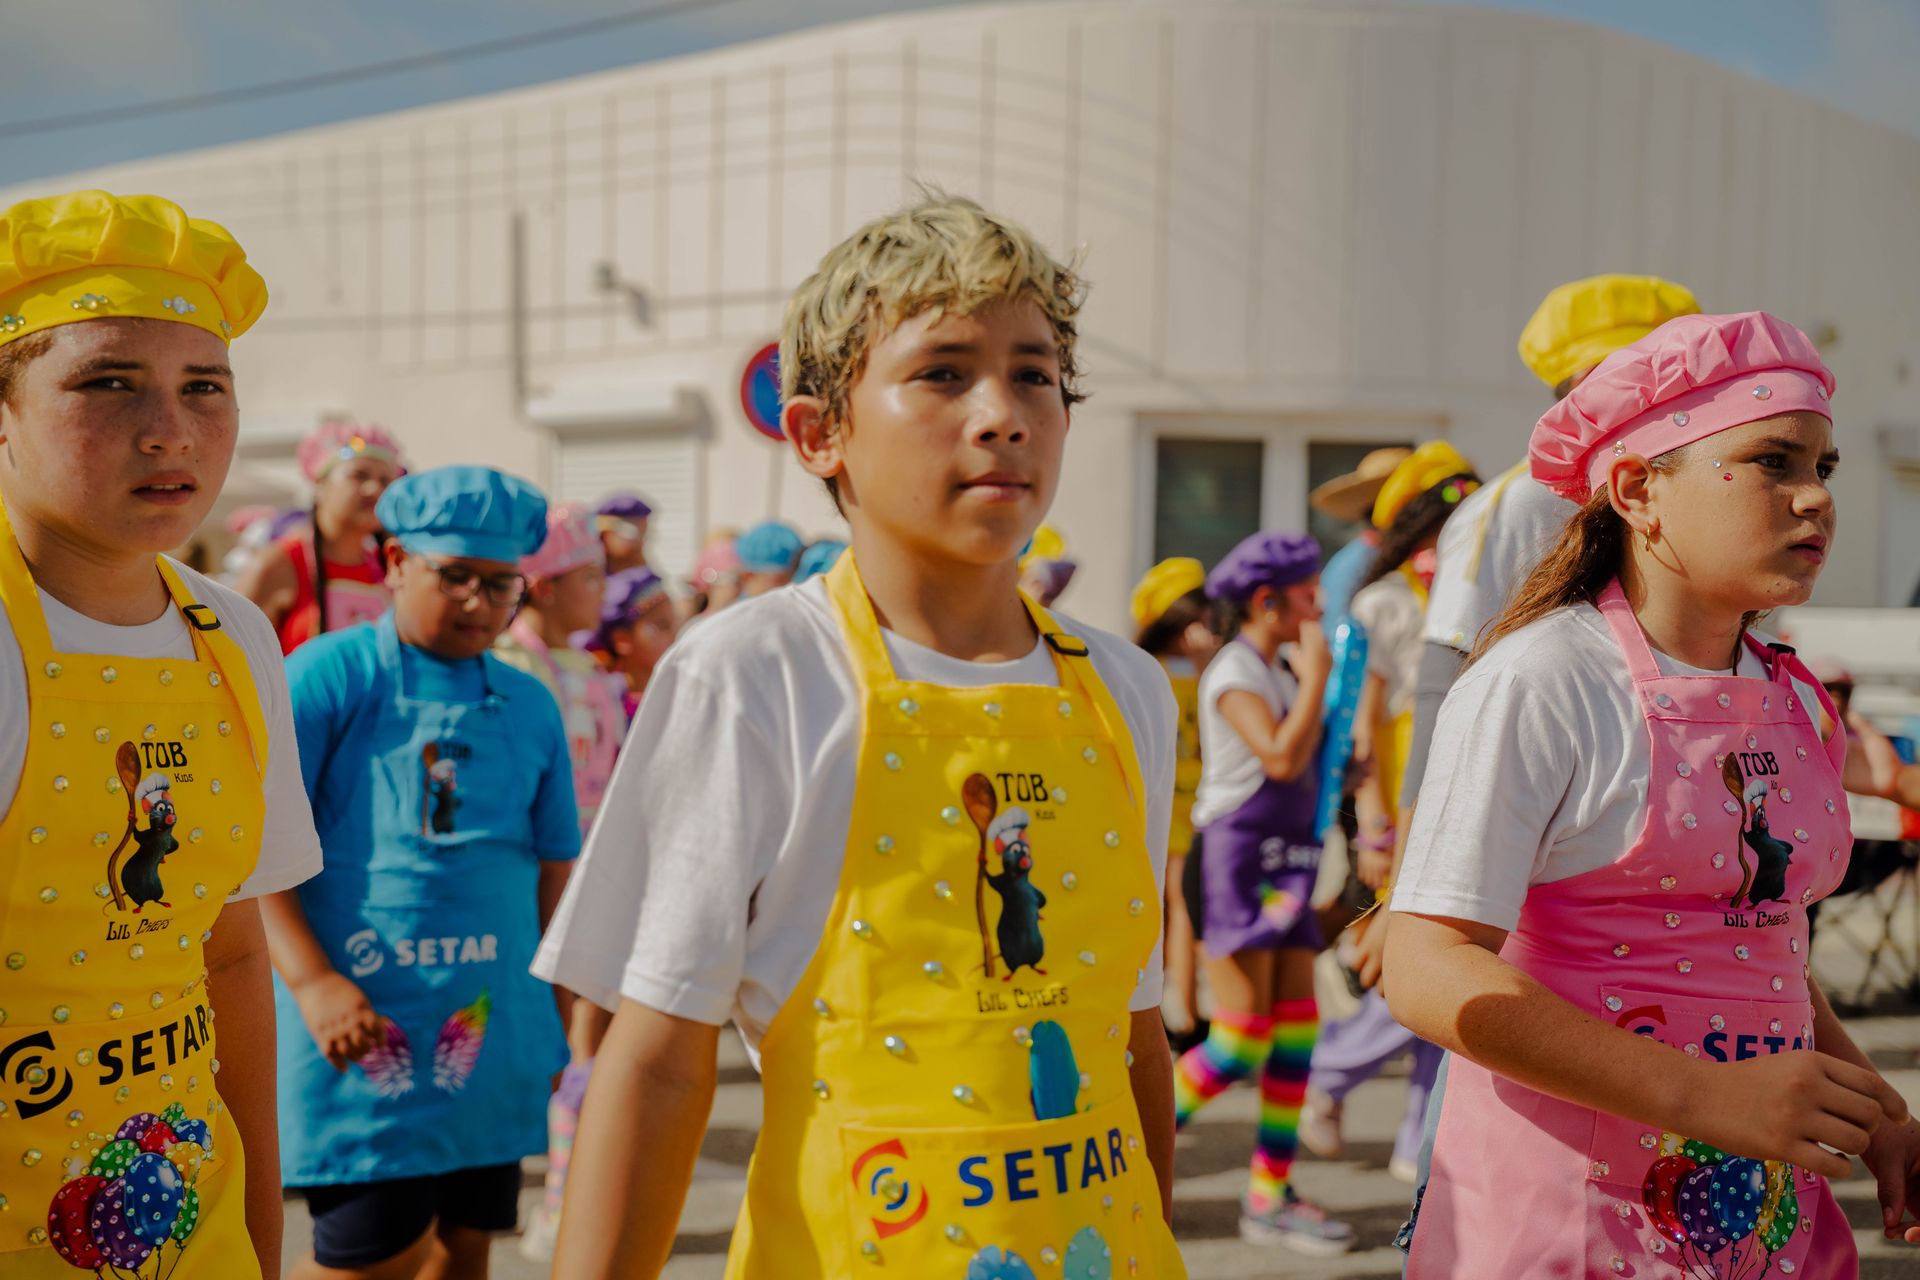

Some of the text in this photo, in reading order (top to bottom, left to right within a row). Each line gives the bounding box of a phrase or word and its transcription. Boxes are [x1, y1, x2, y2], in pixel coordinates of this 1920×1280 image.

[140, 741, 188, 769] TOB
[1739, 751, 1780, 777] TOB
[996, 772, 1049, 802] TOB
[396, 934, 498, 967] SETAR
[97, 1004, 210, 1086] SETAR
[957, 1127, 1128, 1208] SETAR
